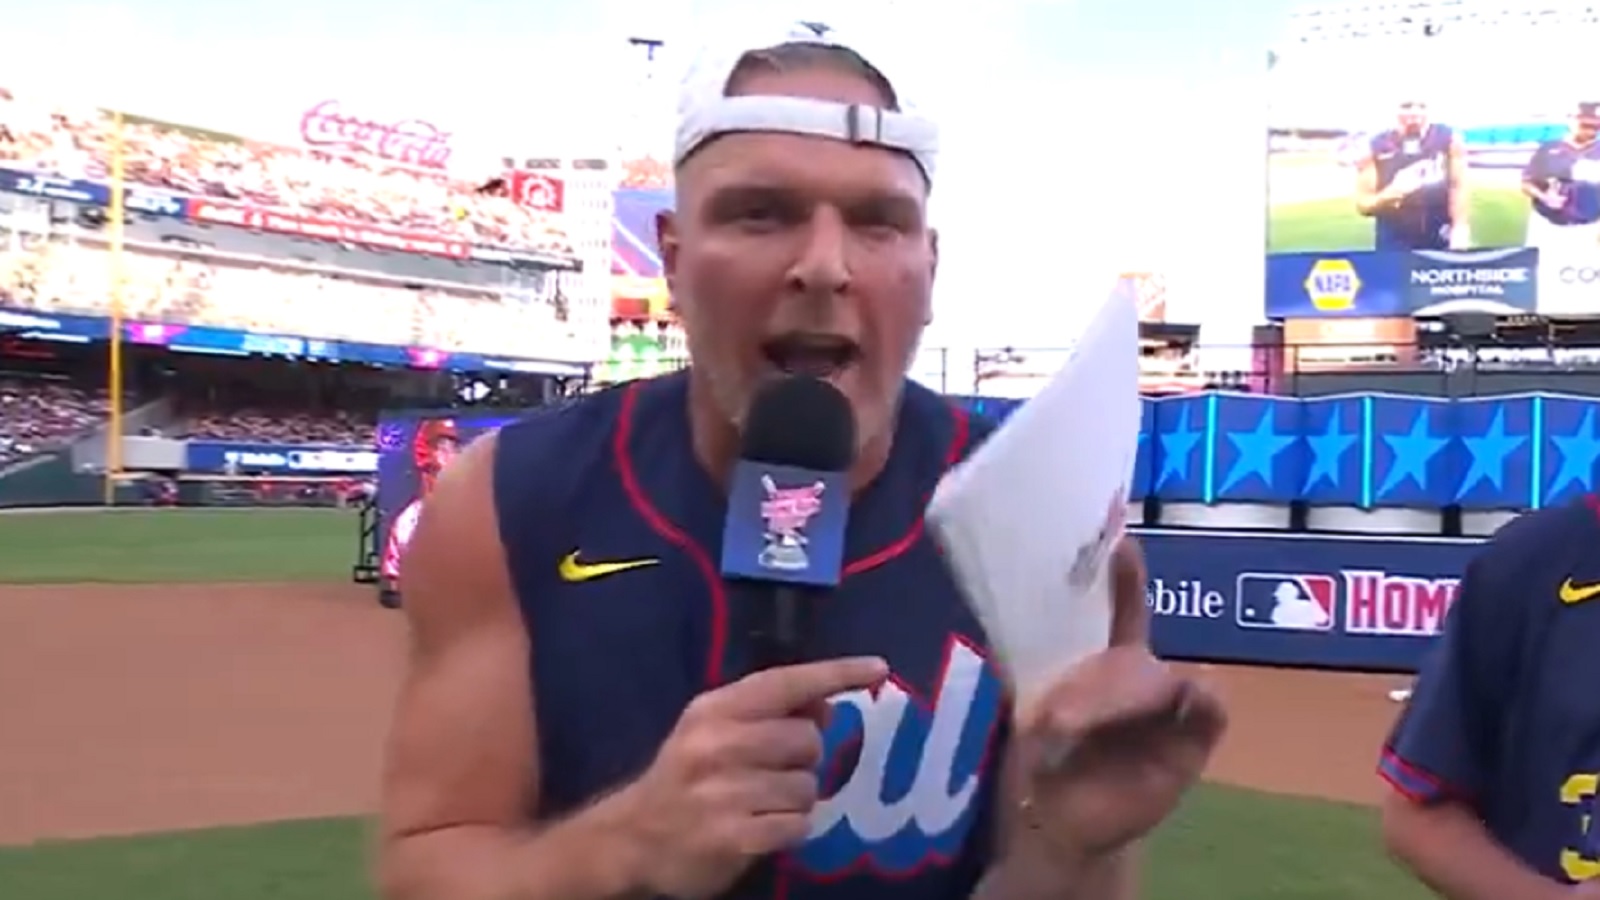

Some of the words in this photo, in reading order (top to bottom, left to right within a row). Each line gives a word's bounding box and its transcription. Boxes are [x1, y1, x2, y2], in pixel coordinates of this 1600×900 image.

[1315, 273, 1351, 293] NAPA
[1411, 267, 1530, 284] NORTHSIDE
[1340, 570, 1462, 636] HOM
